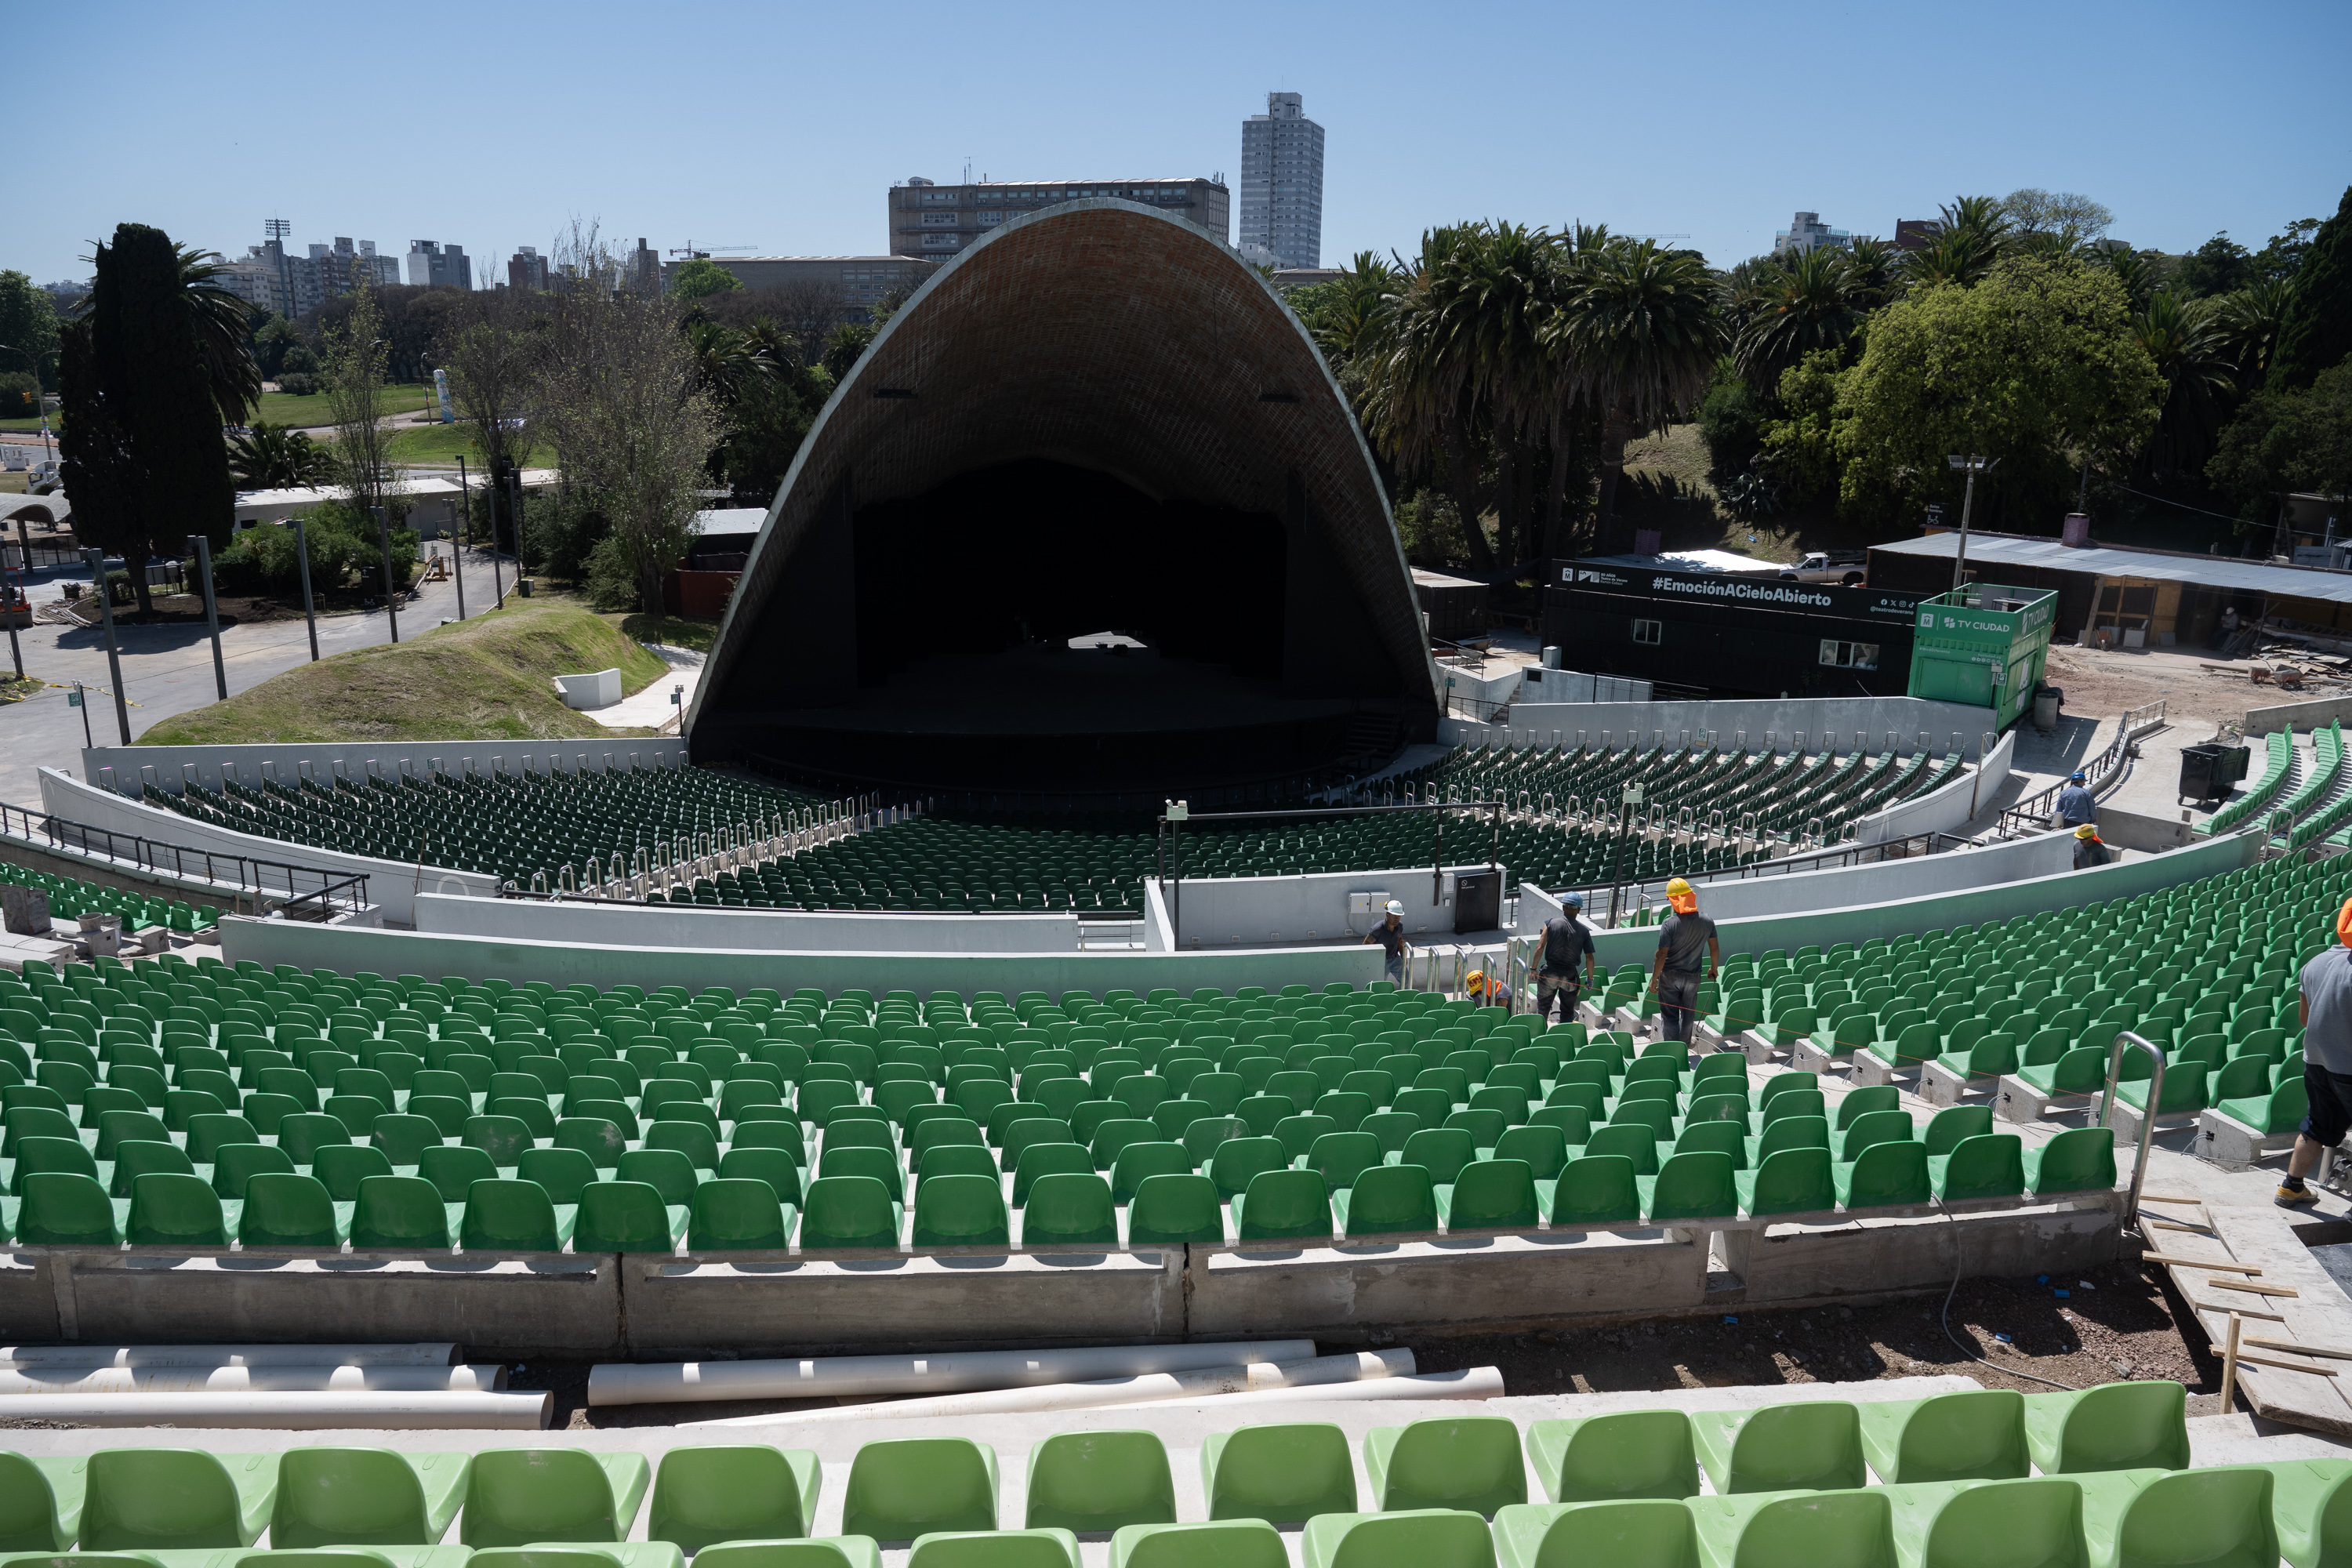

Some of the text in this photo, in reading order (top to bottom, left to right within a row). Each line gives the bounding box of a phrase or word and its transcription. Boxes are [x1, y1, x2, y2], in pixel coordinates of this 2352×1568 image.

[1653, 577, 1831, 606] #EmociónACieloAbierto
[1870, 606, 1915, 615] @teatrodeverano
[1958, 619, 2010, 633] TV CIUDAD
